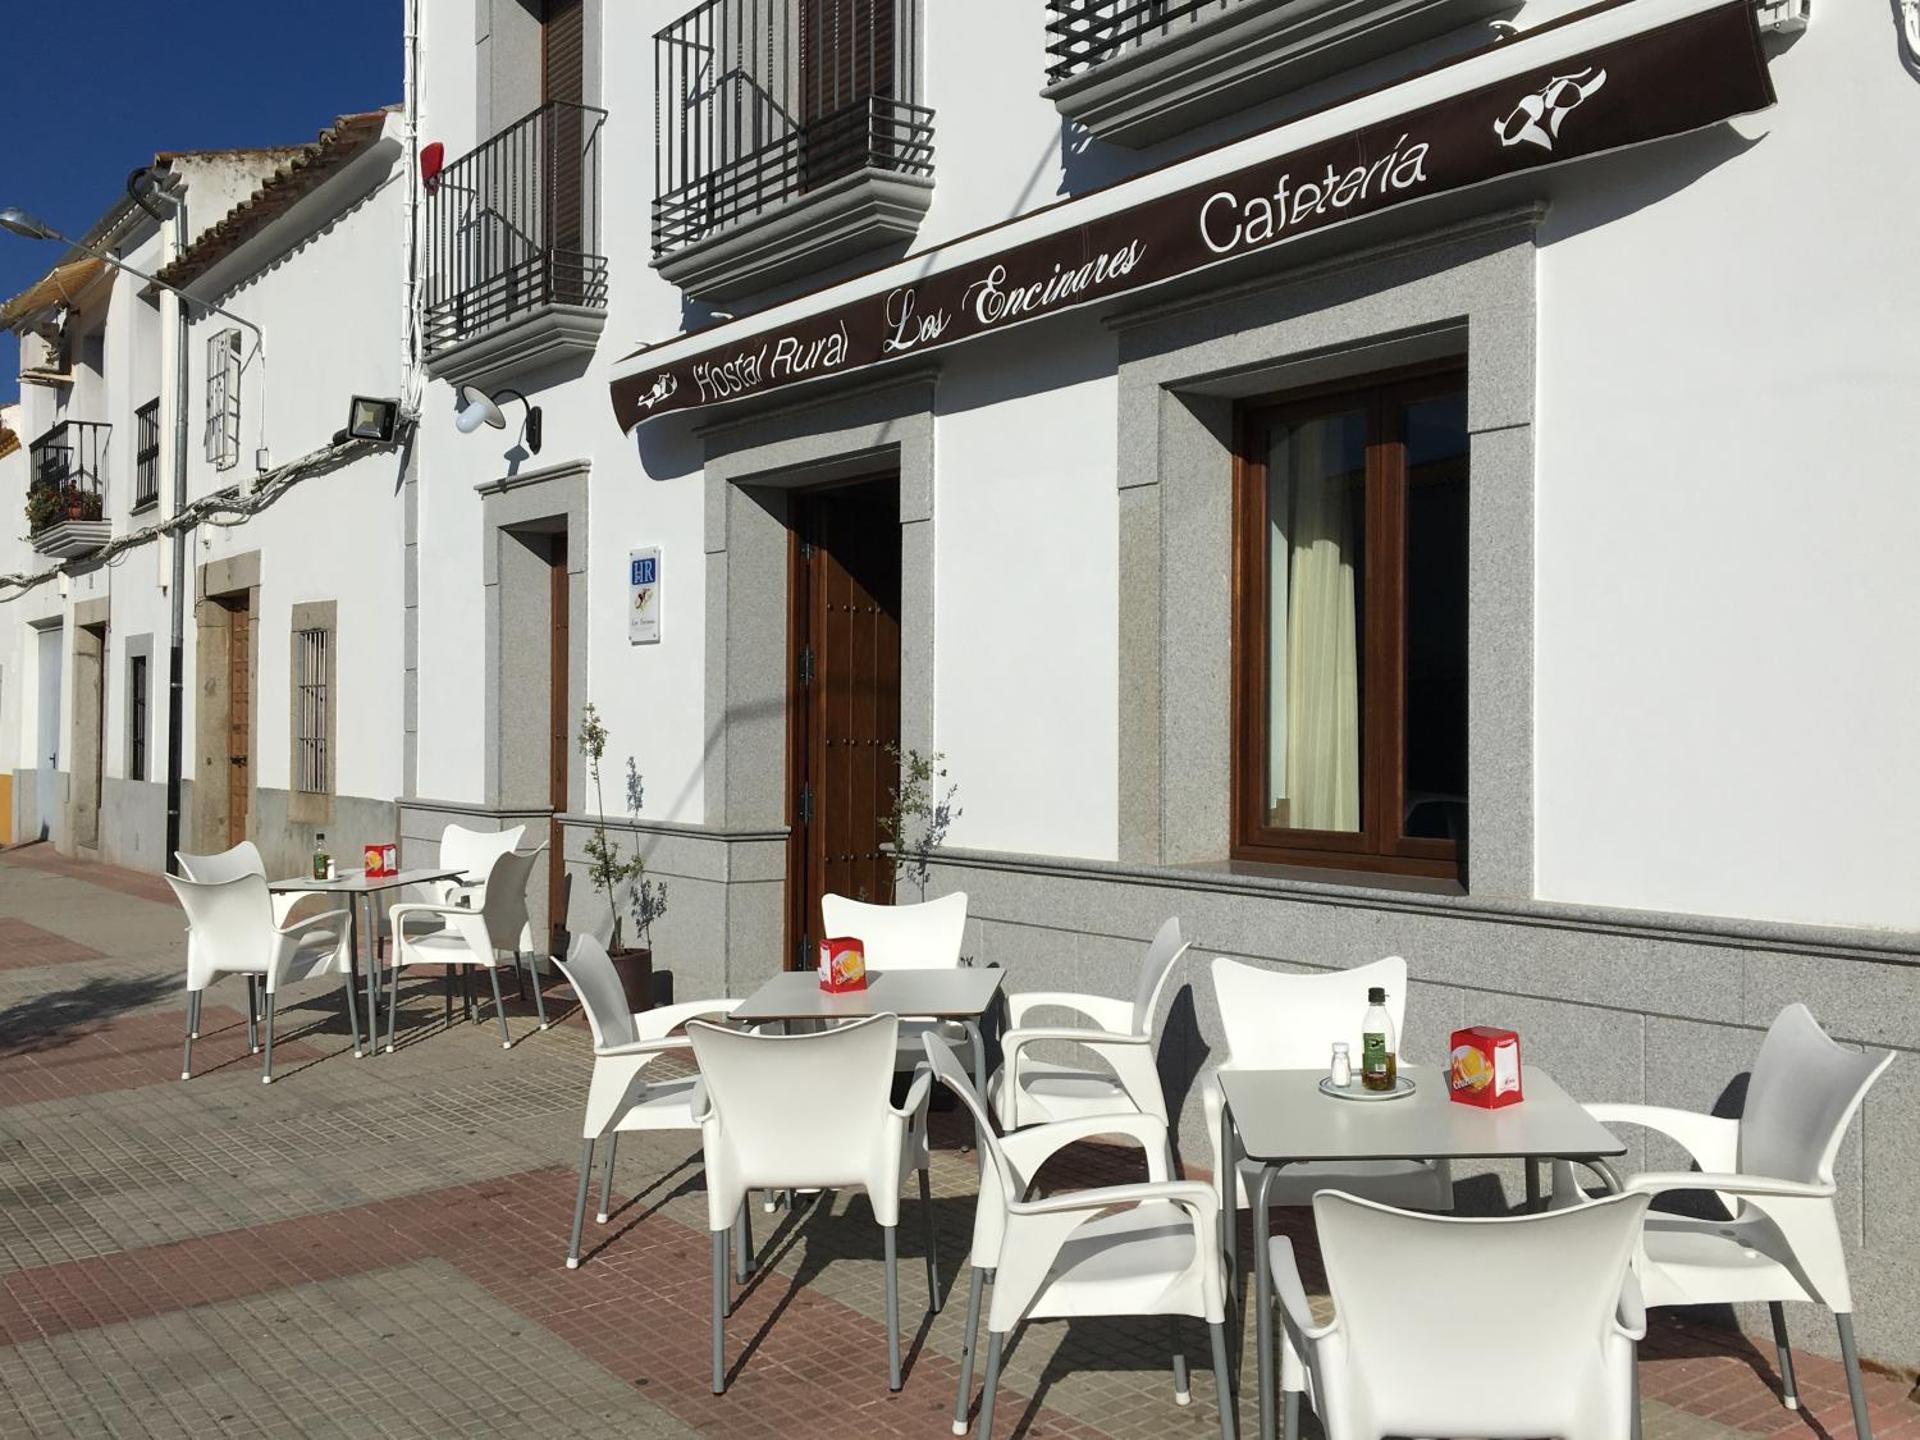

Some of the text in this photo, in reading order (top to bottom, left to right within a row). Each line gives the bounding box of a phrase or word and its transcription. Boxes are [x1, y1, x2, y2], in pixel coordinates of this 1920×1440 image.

[694, 134, 1429, 402] Hostal Rural Los Encinares Cafetería
[634, 560, 653, 583] HR
